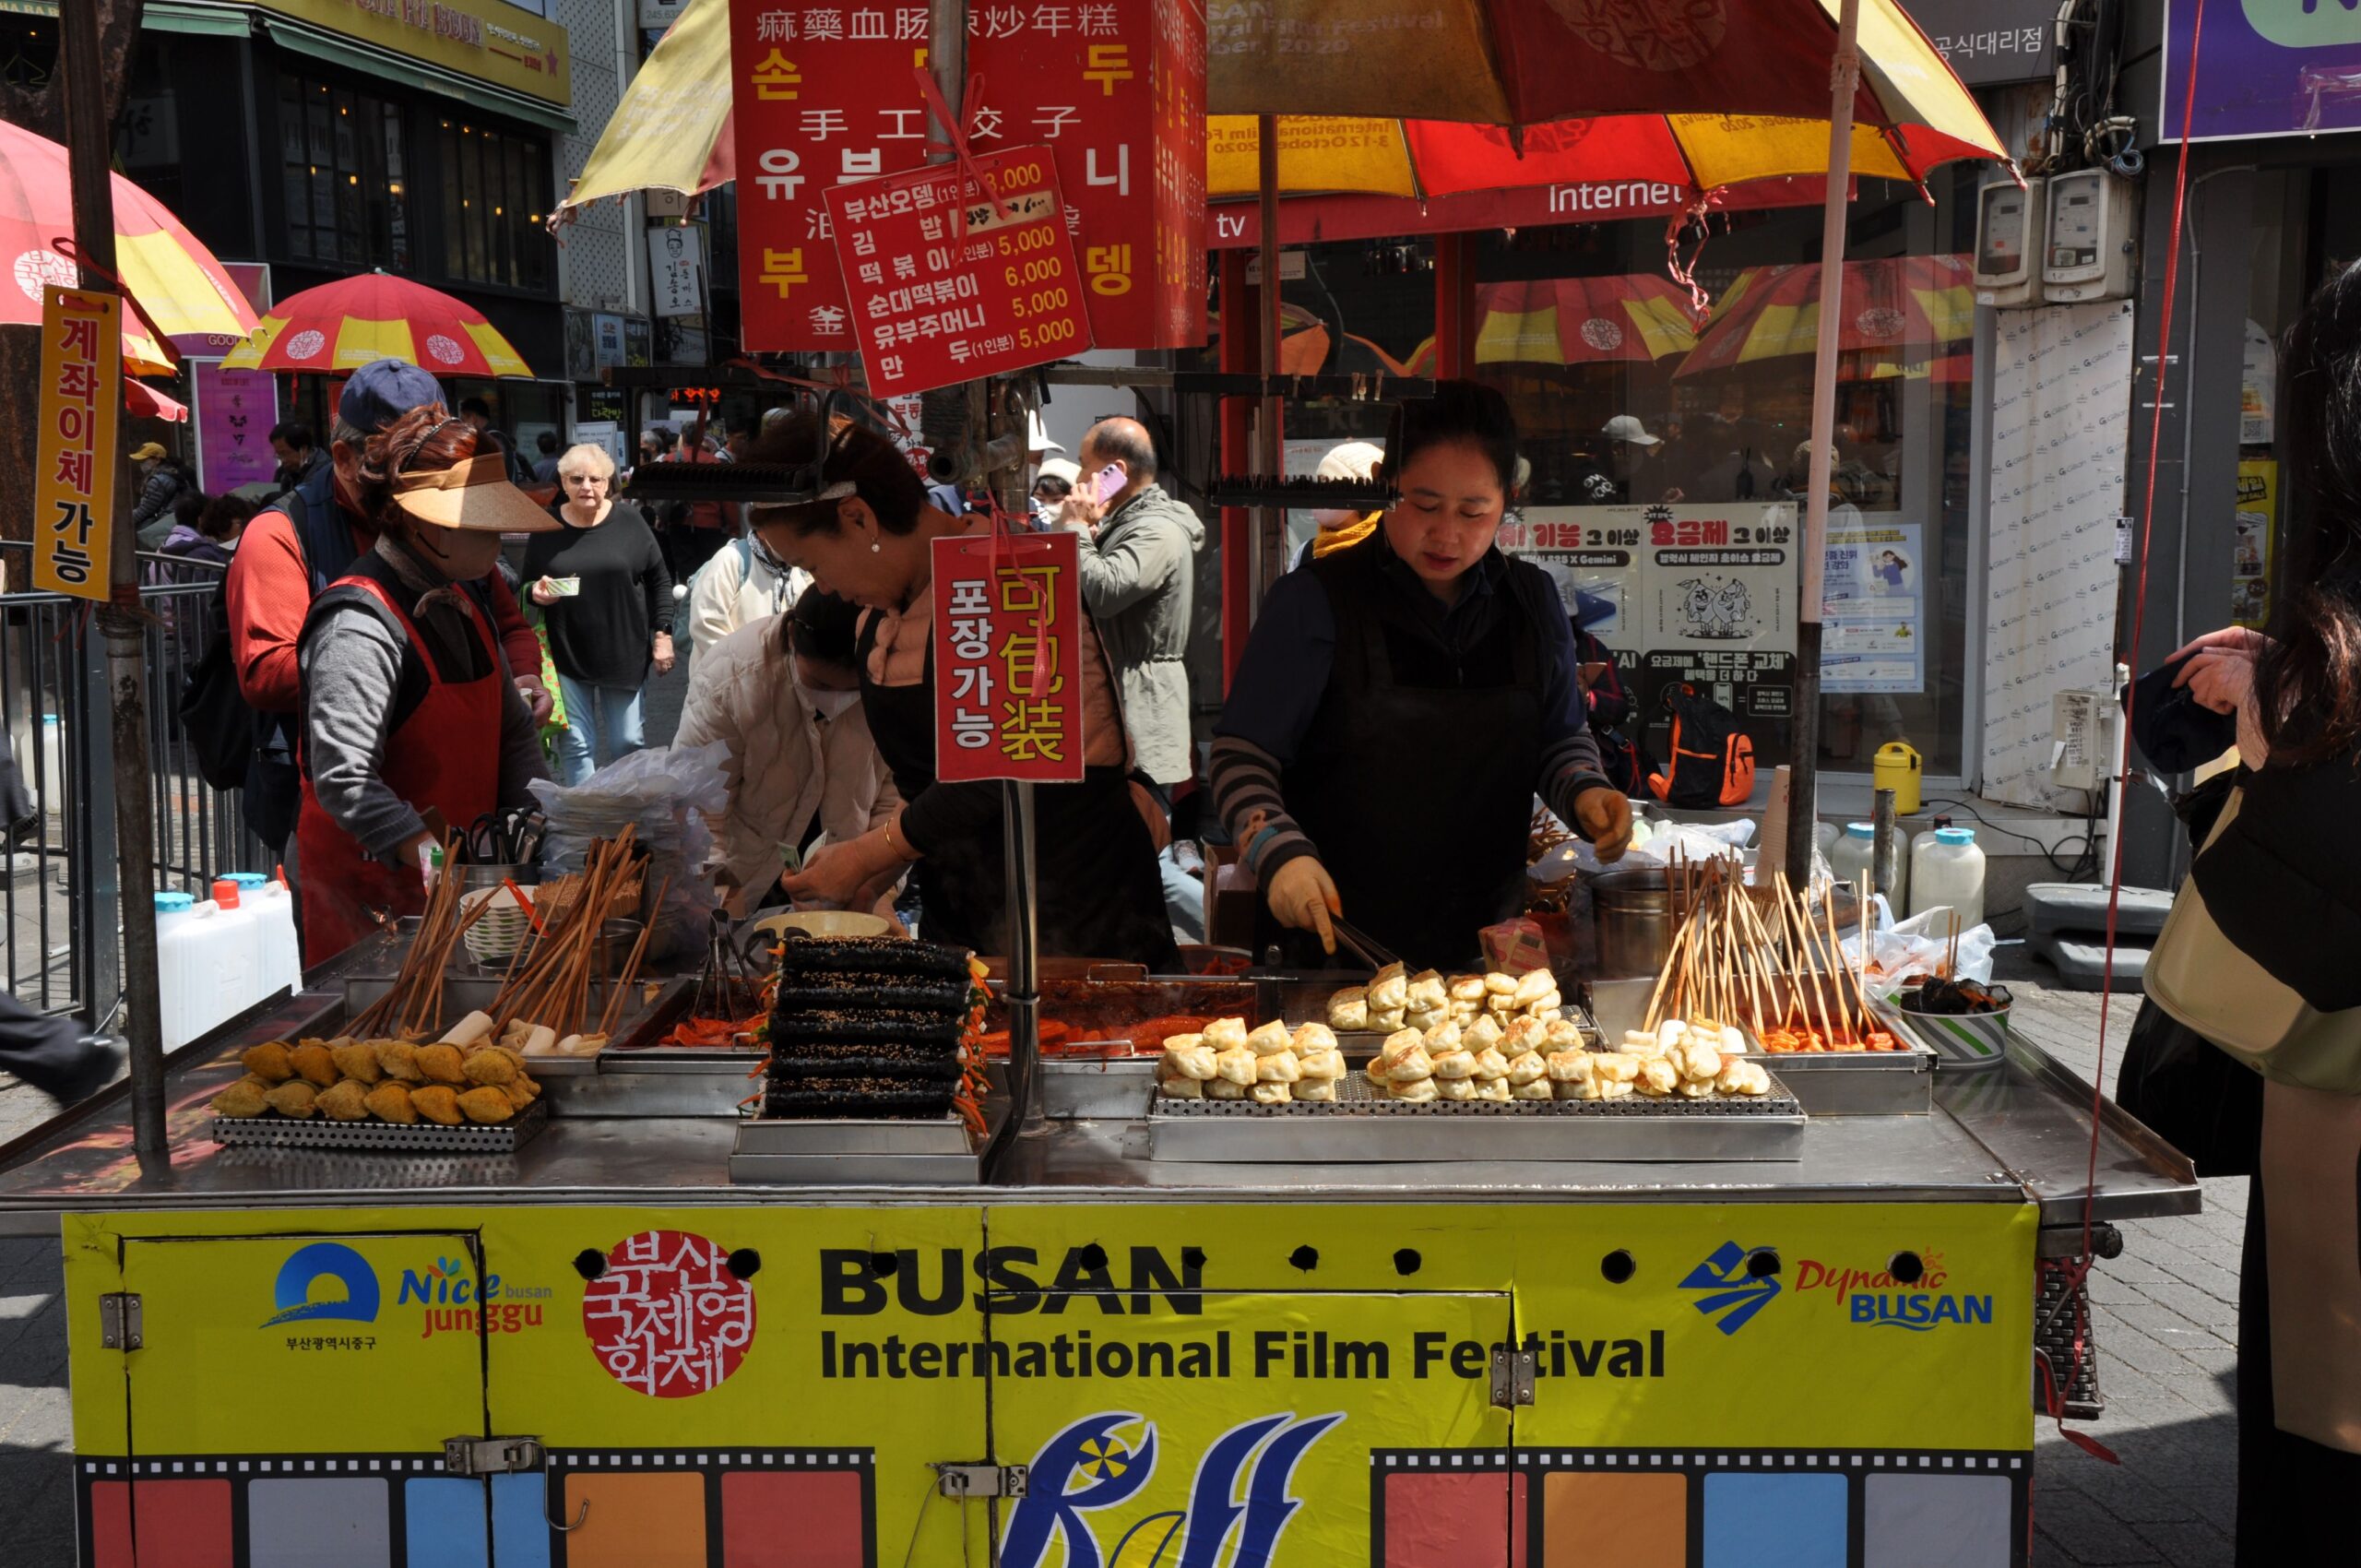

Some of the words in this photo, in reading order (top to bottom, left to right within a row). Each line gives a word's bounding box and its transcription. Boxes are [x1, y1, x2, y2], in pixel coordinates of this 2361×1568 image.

[1936, 26, 2042, 60] 공식대리점
[1549, 183, 1683, 213] Internet
[1216, 212, 1246, 238] tv
[998, 226, 1055, 256] 5,000
[1004, 257, 1061, 288] 6,000
[873, 304, 986, 350] 유부주머니
[1012, 288, 1069, 317] 5,000
[1018, 318, 1075, 349] 5,000
[1651, 520, 1727, 546] 요금제
[1756, 527, 1790, 543] 이상
[1580, 554, 1617, 565] Gemini
[397, 1268, 501, 1304] Nice
[505, 1283, 552, 1299] busan
[820, 1246, 1204, 1316] BUSAN
[1796, 1260, 1948, 1305] Dynaic
[421, 1303, 543, 1338] junggu
[1850, 1294, 1993, 1326] BUSAN
[286, 1336, 377, 1350] 부산광역시중구
[820, 1330, 1230, 1379] International
[1255, 1330, 1390, 1379] Film
[1415, 1329, 1665, 1379] Fetival
